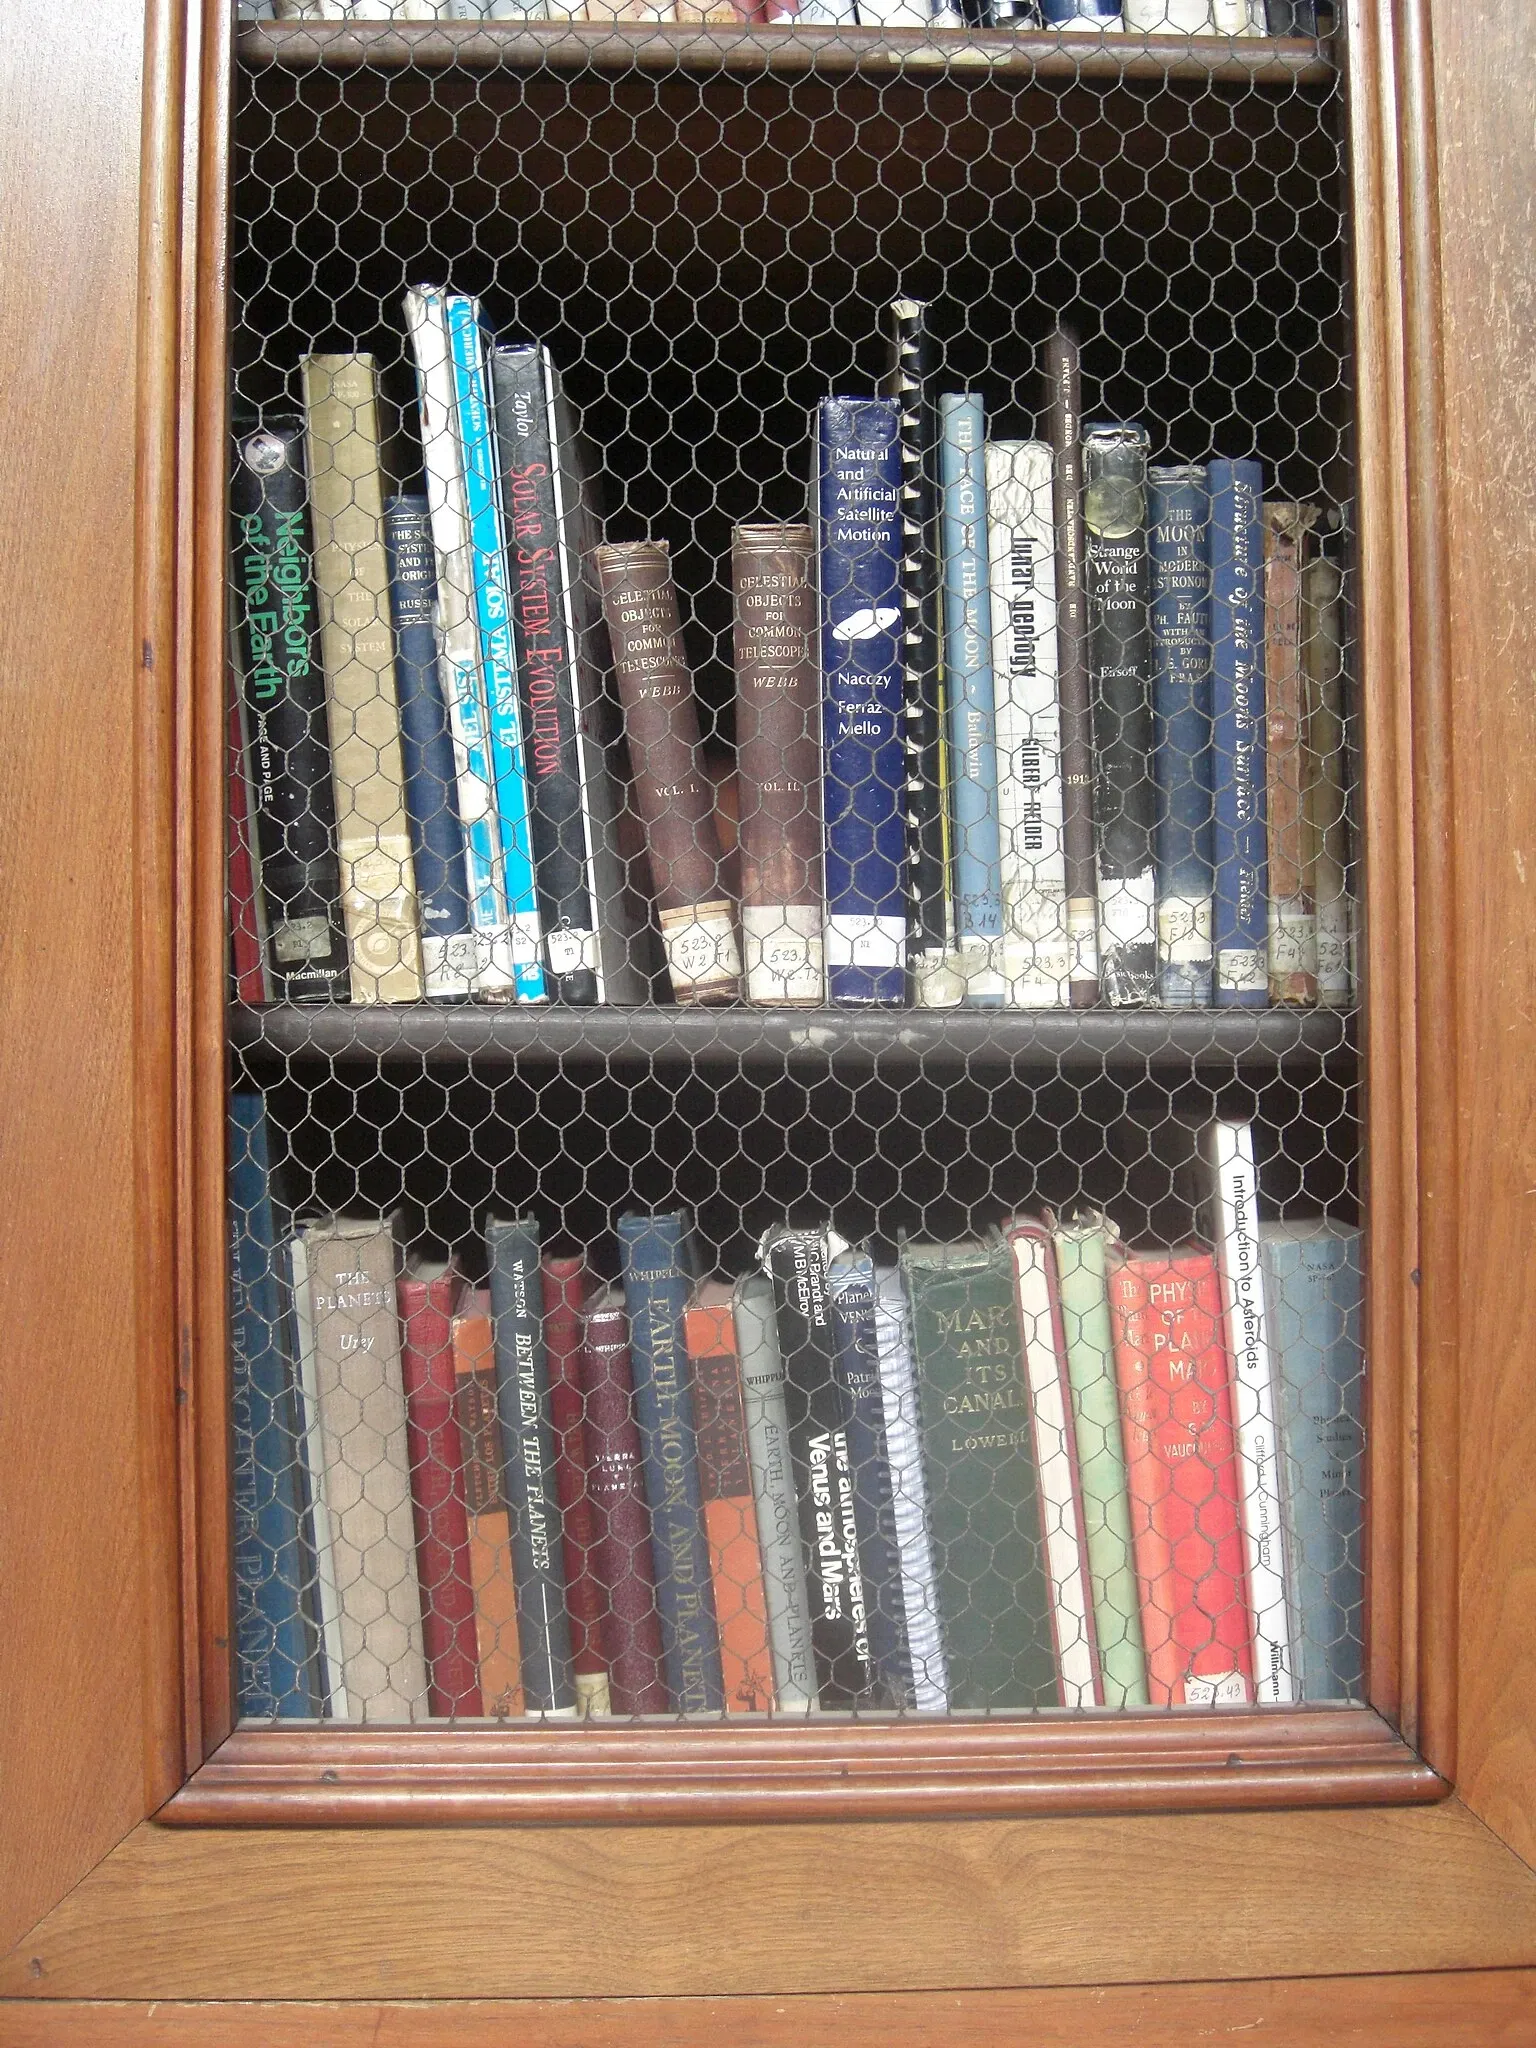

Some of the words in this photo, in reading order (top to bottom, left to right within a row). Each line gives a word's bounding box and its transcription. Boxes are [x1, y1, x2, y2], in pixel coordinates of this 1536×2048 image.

[515, 391, 532, 438] Taylor
[957, 416, 974, 456] THE
[836, 446, 889, 461] Natural
[837, 467, 865, 480] and
[1065, 464, 1073, 481] DES
[510, 462, 547, 540] SOLAR
[837, 487, 897, 501] Artificial
[959, 468, 975, 515] FACE
[837, 507, 895, 522] Satellite
[1169, 510, 1193, 521] THE
[240, 513, 271, 547] of
[392, 530, 412, 540] THE
[837, 527, 891, 541] Motion
[961, 527, 976, 550] OF
[1156, 525, 1206, 543] MOON
[1234, 480, 1252, 578] Structure
[1089, 545, 1141, 561] Strange
[1177, 546, 1188, 556] IN
[350, 567, 366, 577] OF
[400, 558, 421, 568] AND
[1010, 537, 1039, 590] lunar
[1095, 562, 1138, 575] World
[243, 556, 271, 607] the
[962, 560, 977, 597] THE
[1096, 580, 1113, 593] of
[1115, 579, 1137, 593] the
[274, 511, 310, 678] Neighbors
[347, 592, 373, 602] THE
[517, 548, 554, 636] SYSTEM
[746, 596, 802, 607] OBJECTS
[1229, 587, 1248, 608] of
[1069, 603, 1078, 618] DIE
[963, 608, 980, 668] MOON
[1009, 600, 1040, 679] geology
[1163, 628, 1188, 636] WITH
[1235, 618, 1253, 650] the
[250, 611, 283, 699] Earth
[340, 642, 387, 653] SYSTEM
[1180, 647, 1192, 655] BY
[639, 686, 682, 699] WEBB
[753, 677, 799, 688] WEBB
[526, 647, 563, 775] EVOLUTION
[500, 720, 518, 749] EL
[838, 721, 881, 736] Mello
[967, 710, 981, 779] Baldwin
[260, 747, 272, 769] AND
[1236, 740, 1256, 822] Surface
[286, 969, 338, 981] Macmillan
[1232, 1174, 1250, 1272] Introduction
[1307, 1263, 1336, 1272] NASA
[336, 1271, 370, 1287] THE
[512, 1259, 527, 1318] WATSON
[1241, 1276, 1251, 1292] to
[316, 1291, 391, 1310] PLANETS
[813, 1304, 827, 1327] and
[340, 1335, 375, 1354] Urey
[1242, 1298, 1260, 1370] Asteroids
[956, 1337, 1010, 1358] AND
[515, 1332, 538, 1429] BETWEEN
[965, 1364, 1007, 1385] ITS
[648, 1298, 677, 1408] EARTH,
[668, 1523, 695, 1584] AND
[952, 1430, 1029, 1451] LOWELL
[521, 1437, 542, 1478] THE
[1254, 1435, 1267, 1481] Clifford
[808, 1432, 831, 1508] Venus
[526, 1484, 550, 1570] PLANETS
[773, 1492, 792, 1547] MOON
[1258, 1490, 1273, 1566] Cunningham
[815, 1511, 834, 1557] and
[821, 1556, 842, 1621] Mars
